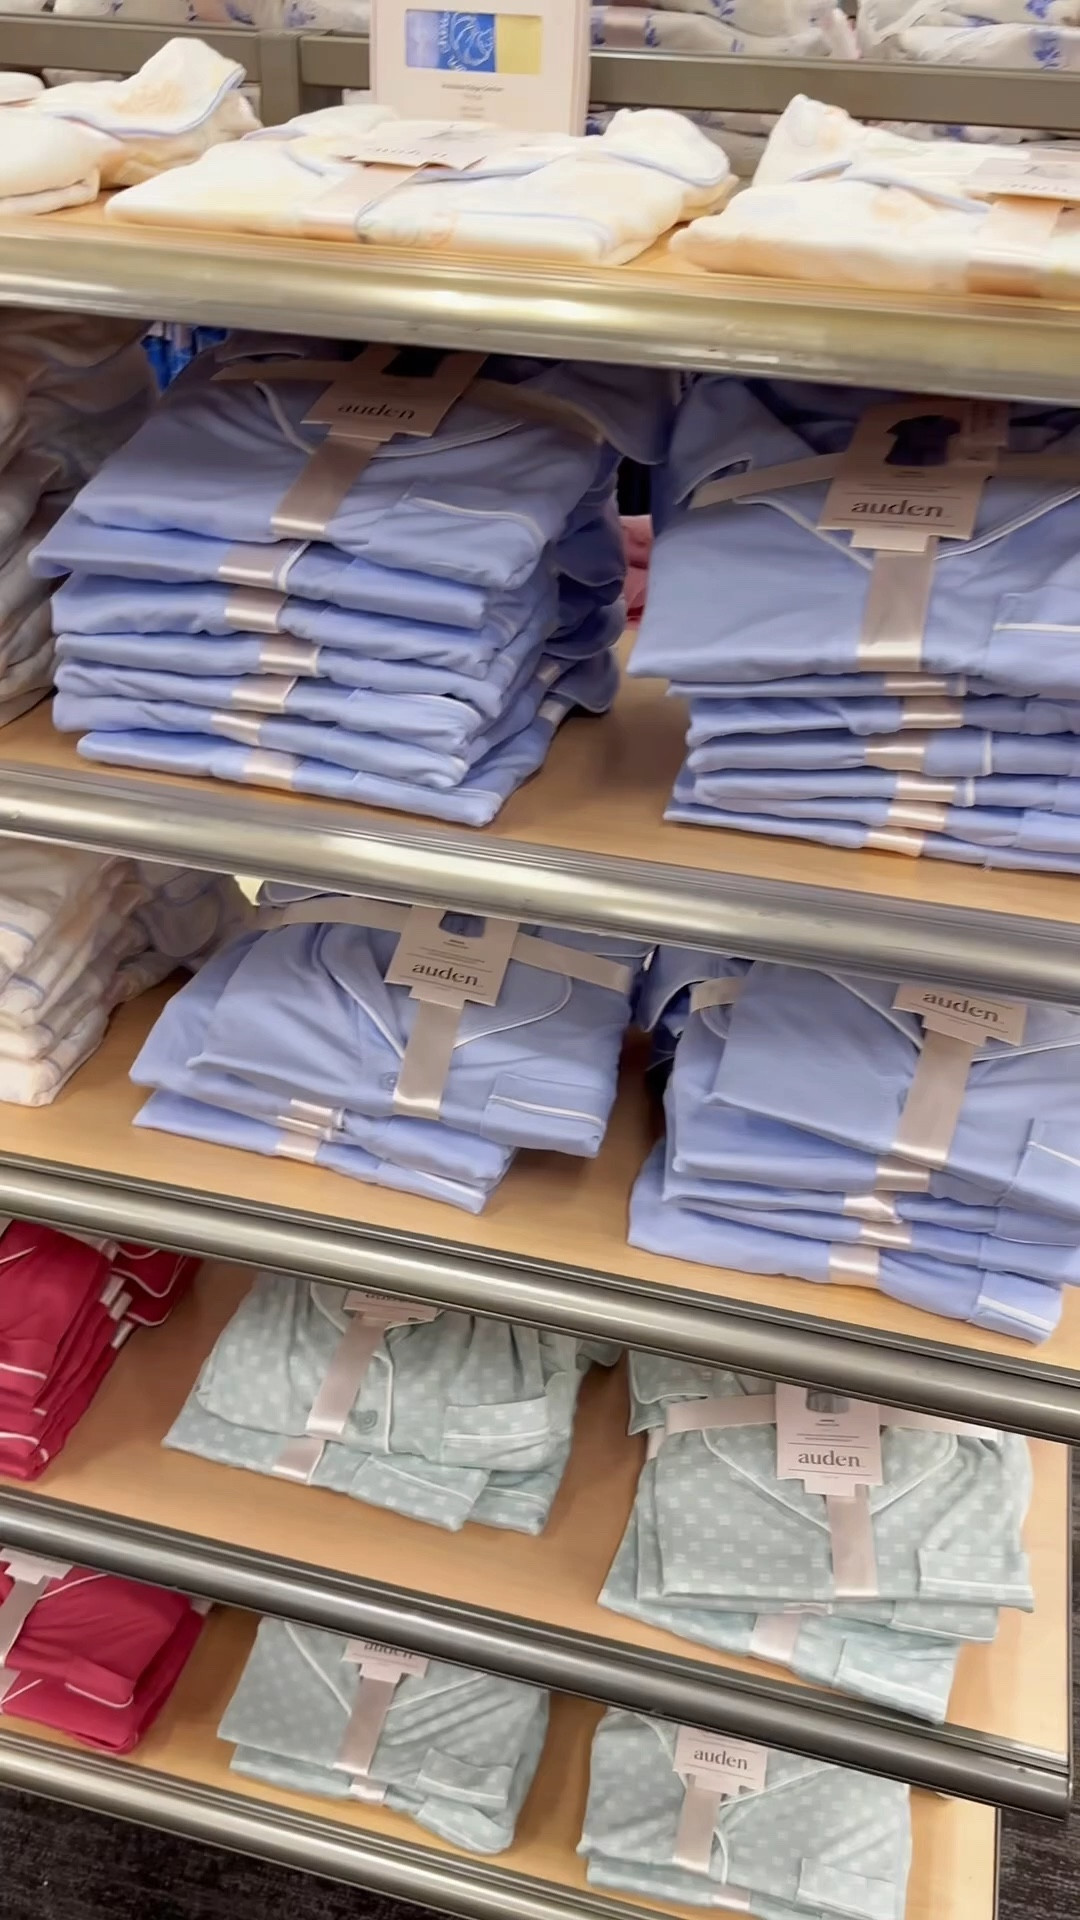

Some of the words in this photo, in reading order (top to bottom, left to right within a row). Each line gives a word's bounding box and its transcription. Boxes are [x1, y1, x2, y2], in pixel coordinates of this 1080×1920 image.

[338, 403, 415, 420] auden
[851, 499, 945, 518] auden
[412, 963, 478, 986] auden
[922, 992, 999, 1023] auden
[798, 1449, 861, 1468] auden
[693, 1749, 748, 1770] auden
